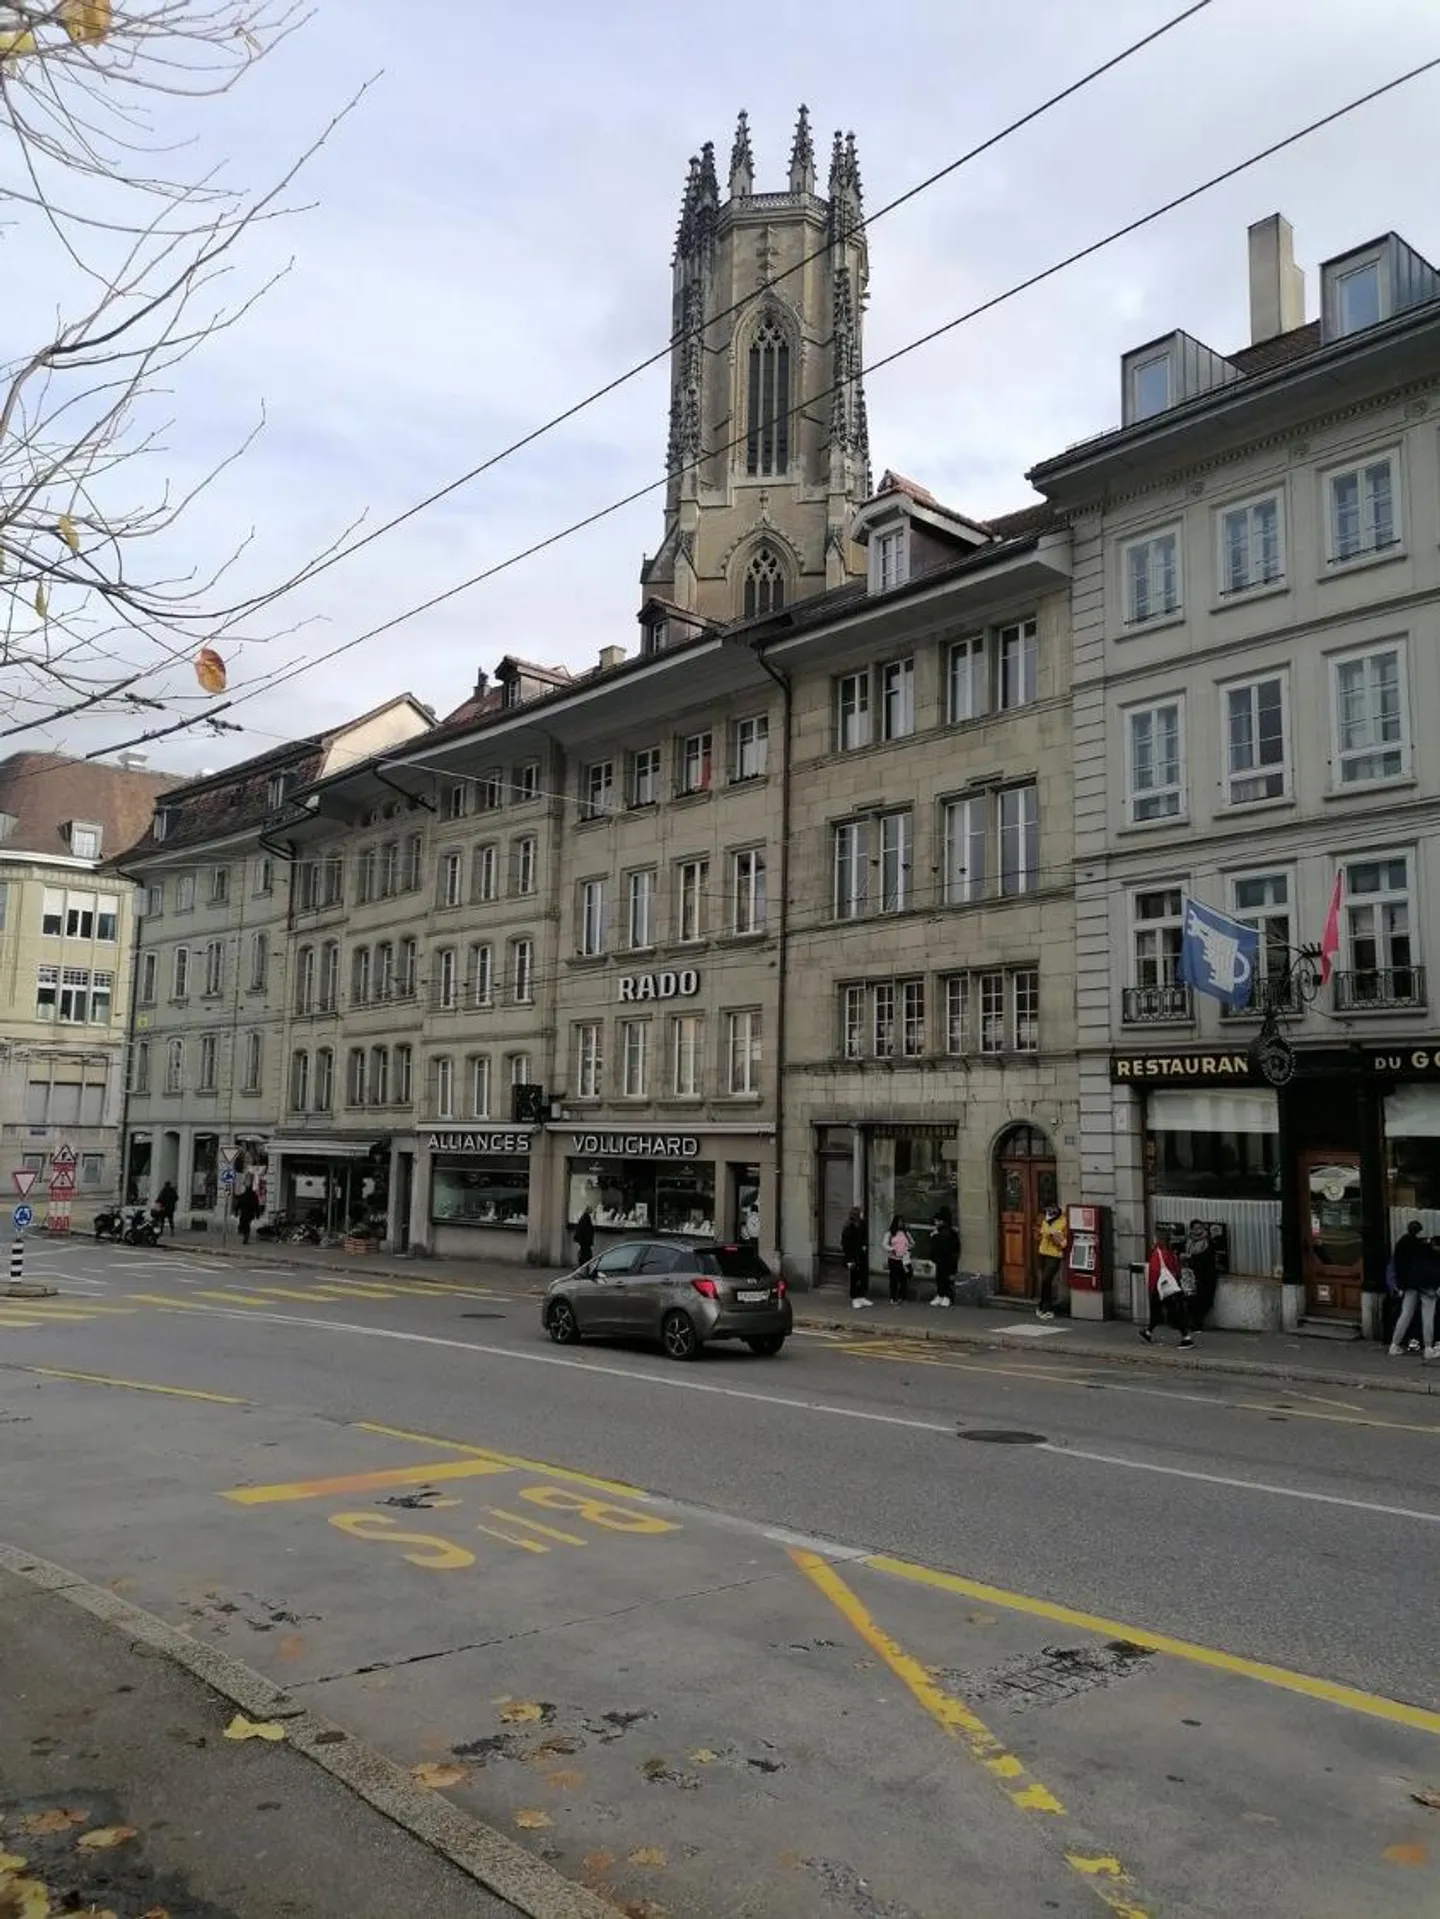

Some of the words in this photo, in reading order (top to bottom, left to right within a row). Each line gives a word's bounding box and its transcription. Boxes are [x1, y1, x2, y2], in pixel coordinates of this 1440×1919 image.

[618, 970, 698, 1001] RADO
[1117, 1056, 1249, 1077] RESTAURAN
[1374, 1056, 1402, 1071] DU
[428, 1133, 529, 1151] ALLIANCES
[573, 1135, 698, 1155] VOLLICHARD
